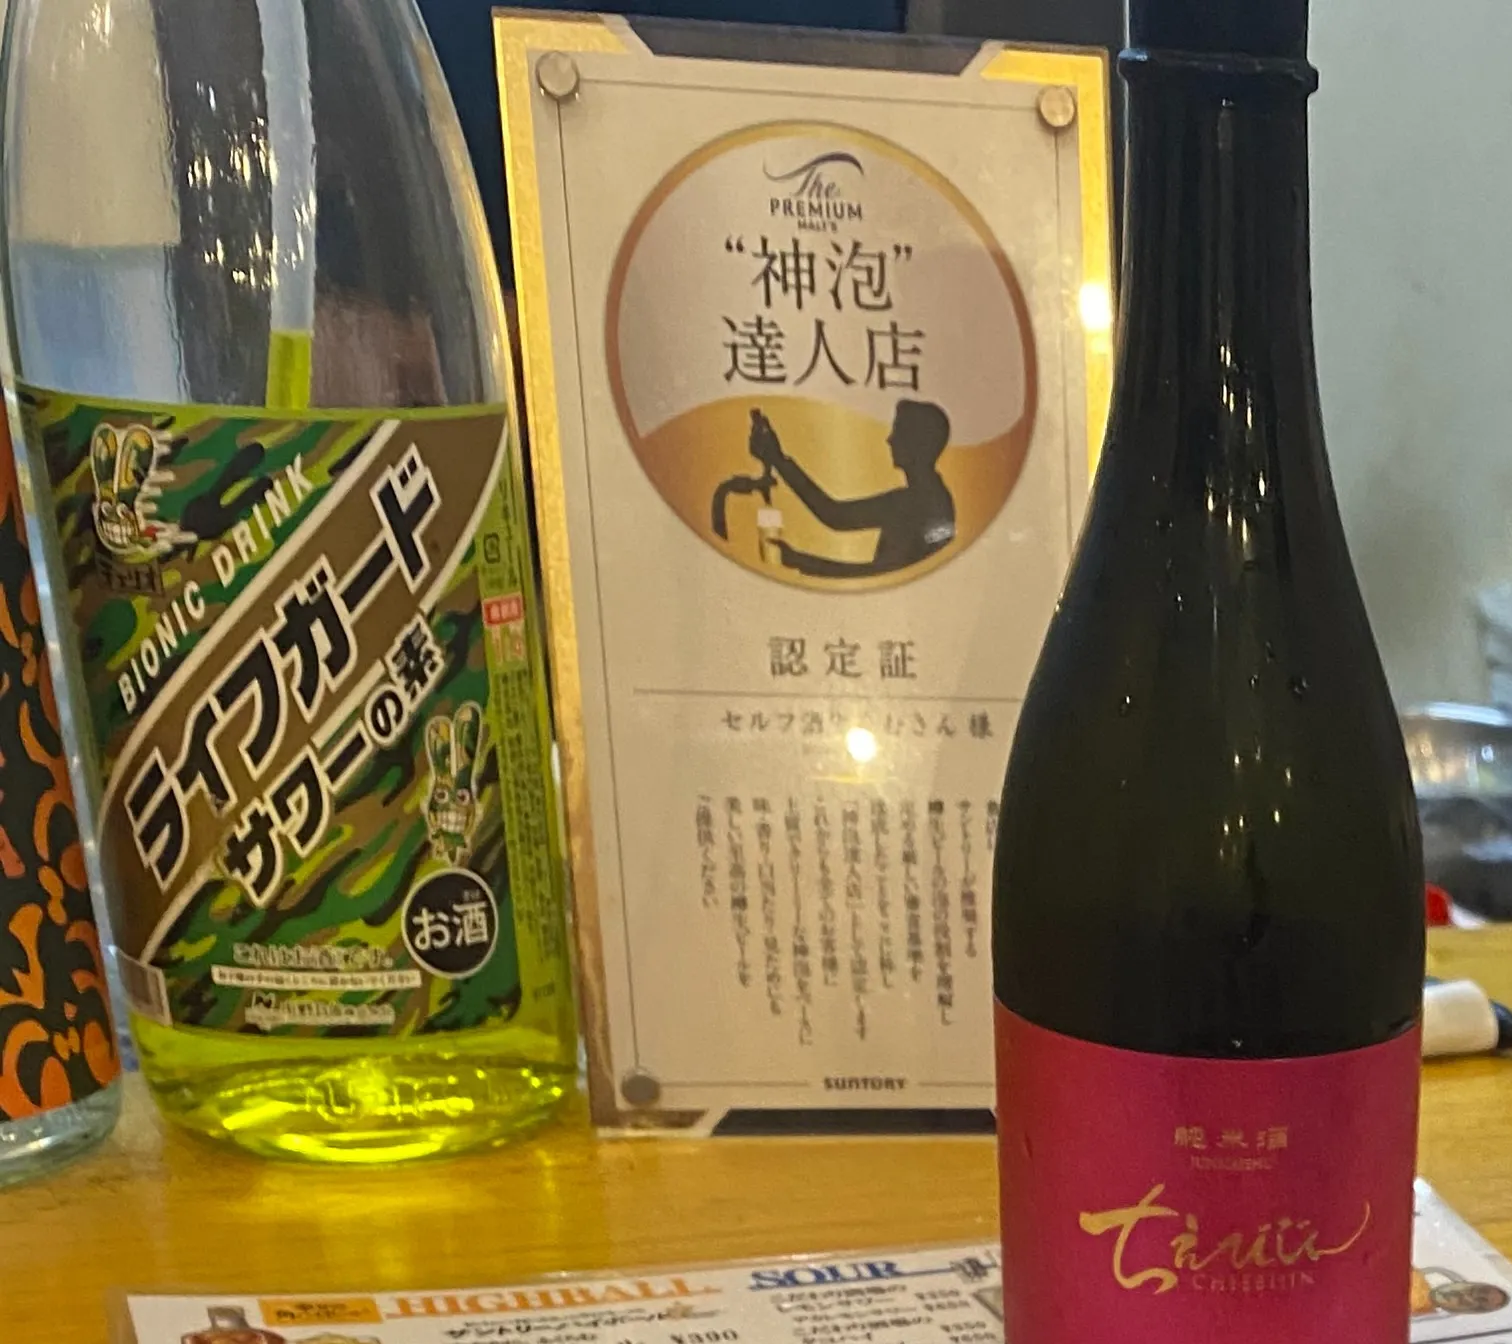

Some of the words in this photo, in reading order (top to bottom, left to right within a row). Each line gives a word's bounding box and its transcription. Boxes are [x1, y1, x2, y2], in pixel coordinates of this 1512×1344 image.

[768, 196, 864, 221] PREMIUM
[721, 315, 927, 391] 達人店
[118, 588, 208, 714] BIONIC
[212, 454, 317, 584] DRINK
[122, 442, 444, 892] ライフガード
[768, 635, 919, 681] 認定証
[221, 612, 447, 909] サワーの素
[409, 895, 491, 953] お酒
[823, 1074, 908, 1092] SUNTORY
[399, 1277, 714, 1318] HIGHBALL
[745, 1260, 905, 1287] SOUR
